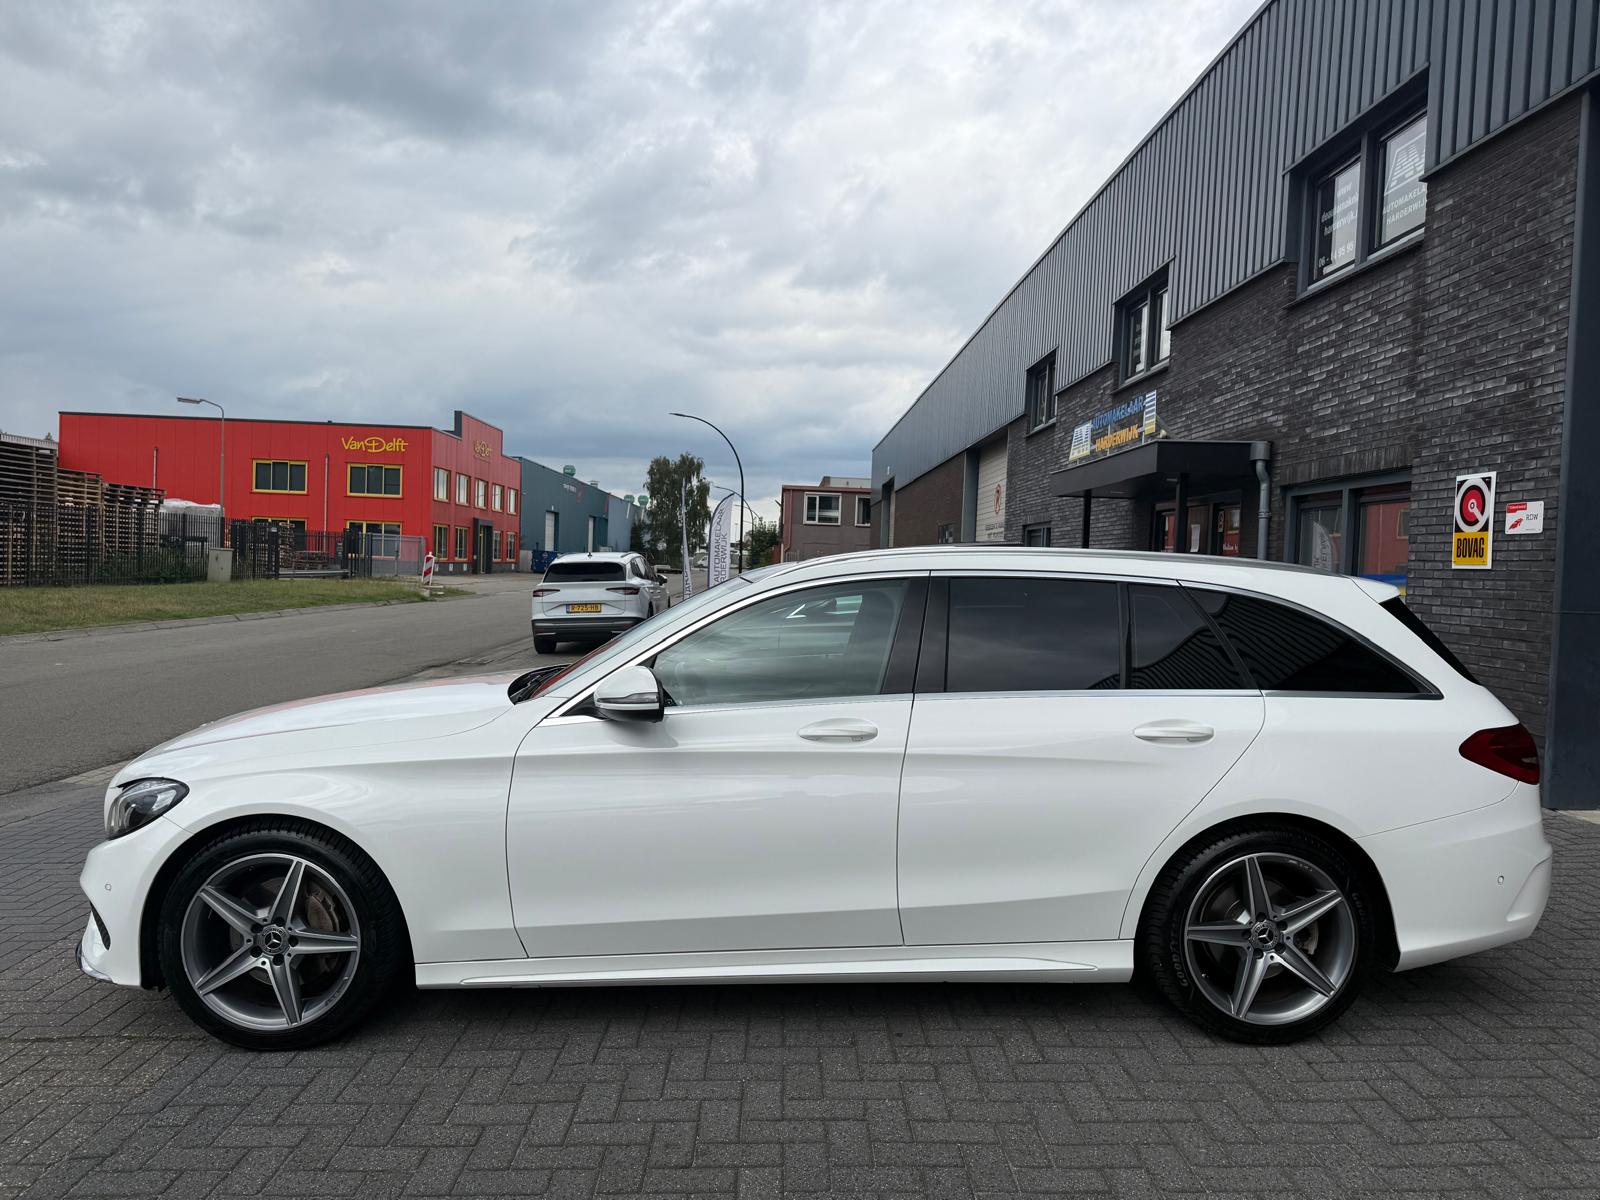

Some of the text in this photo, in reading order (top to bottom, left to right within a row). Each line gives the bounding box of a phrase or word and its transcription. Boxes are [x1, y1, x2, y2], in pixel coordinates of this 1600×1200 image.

[1387, 197, 1427, 225] HARDERWIJ
[1091, 396, 1144, 431] AUTOMAKELAAR
[1095, 424, 1139, 452] HARDERWIJK
[713, 507, 724, 583] AUTOMAKELAAR
[1456, 537, 1485, 558] BOVAG
